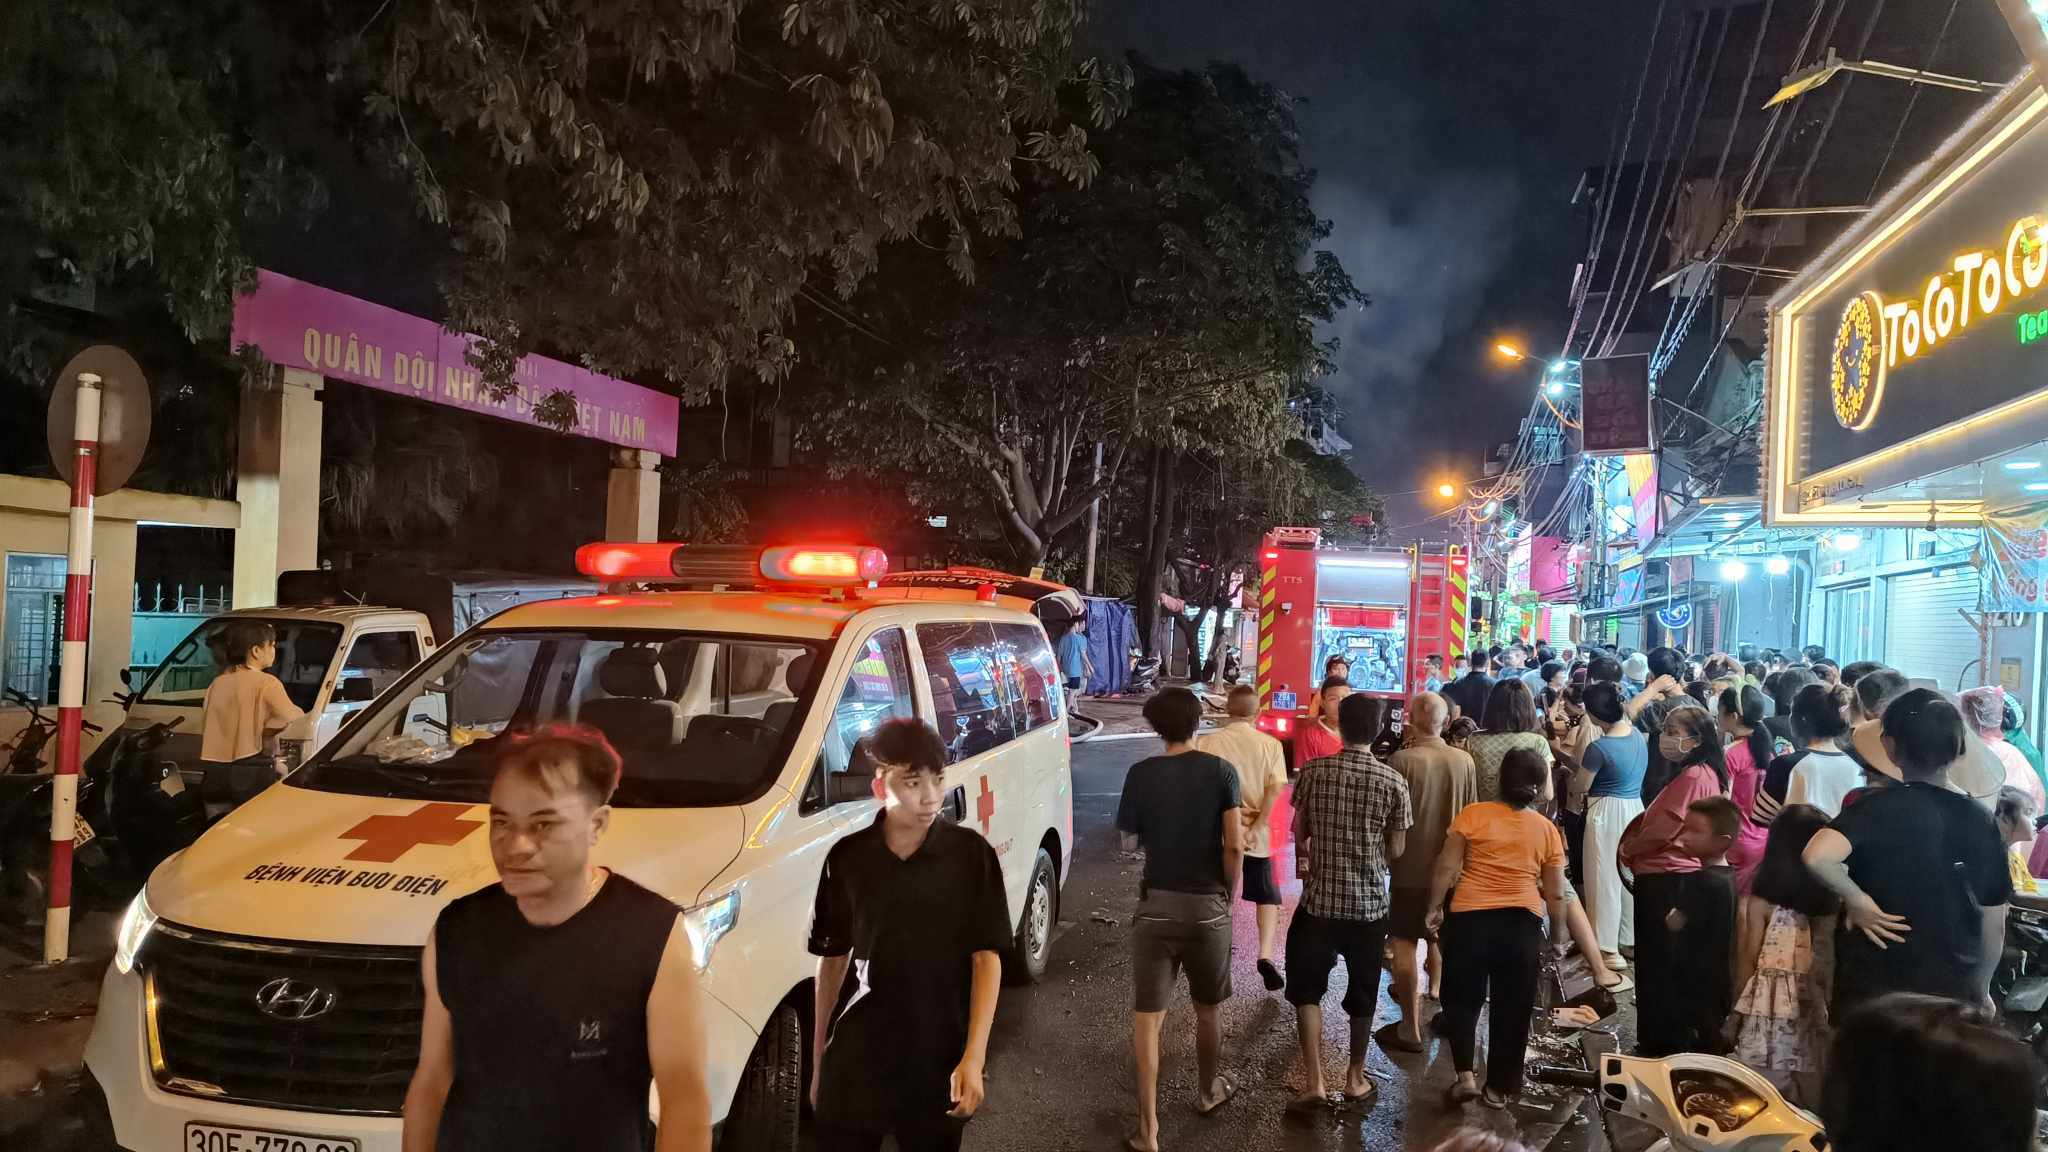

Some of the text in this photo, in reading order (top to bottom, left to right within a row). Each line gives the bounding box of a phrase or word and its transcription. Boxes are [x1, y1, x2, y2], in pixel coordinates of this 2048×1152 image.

[304, 328, 382, 379] QUÂN
[394, 351, 434, 397] ĐỘI
[244, 862, 306, 883] BỆNH
[299, 866, 353, 888] VIỆN
